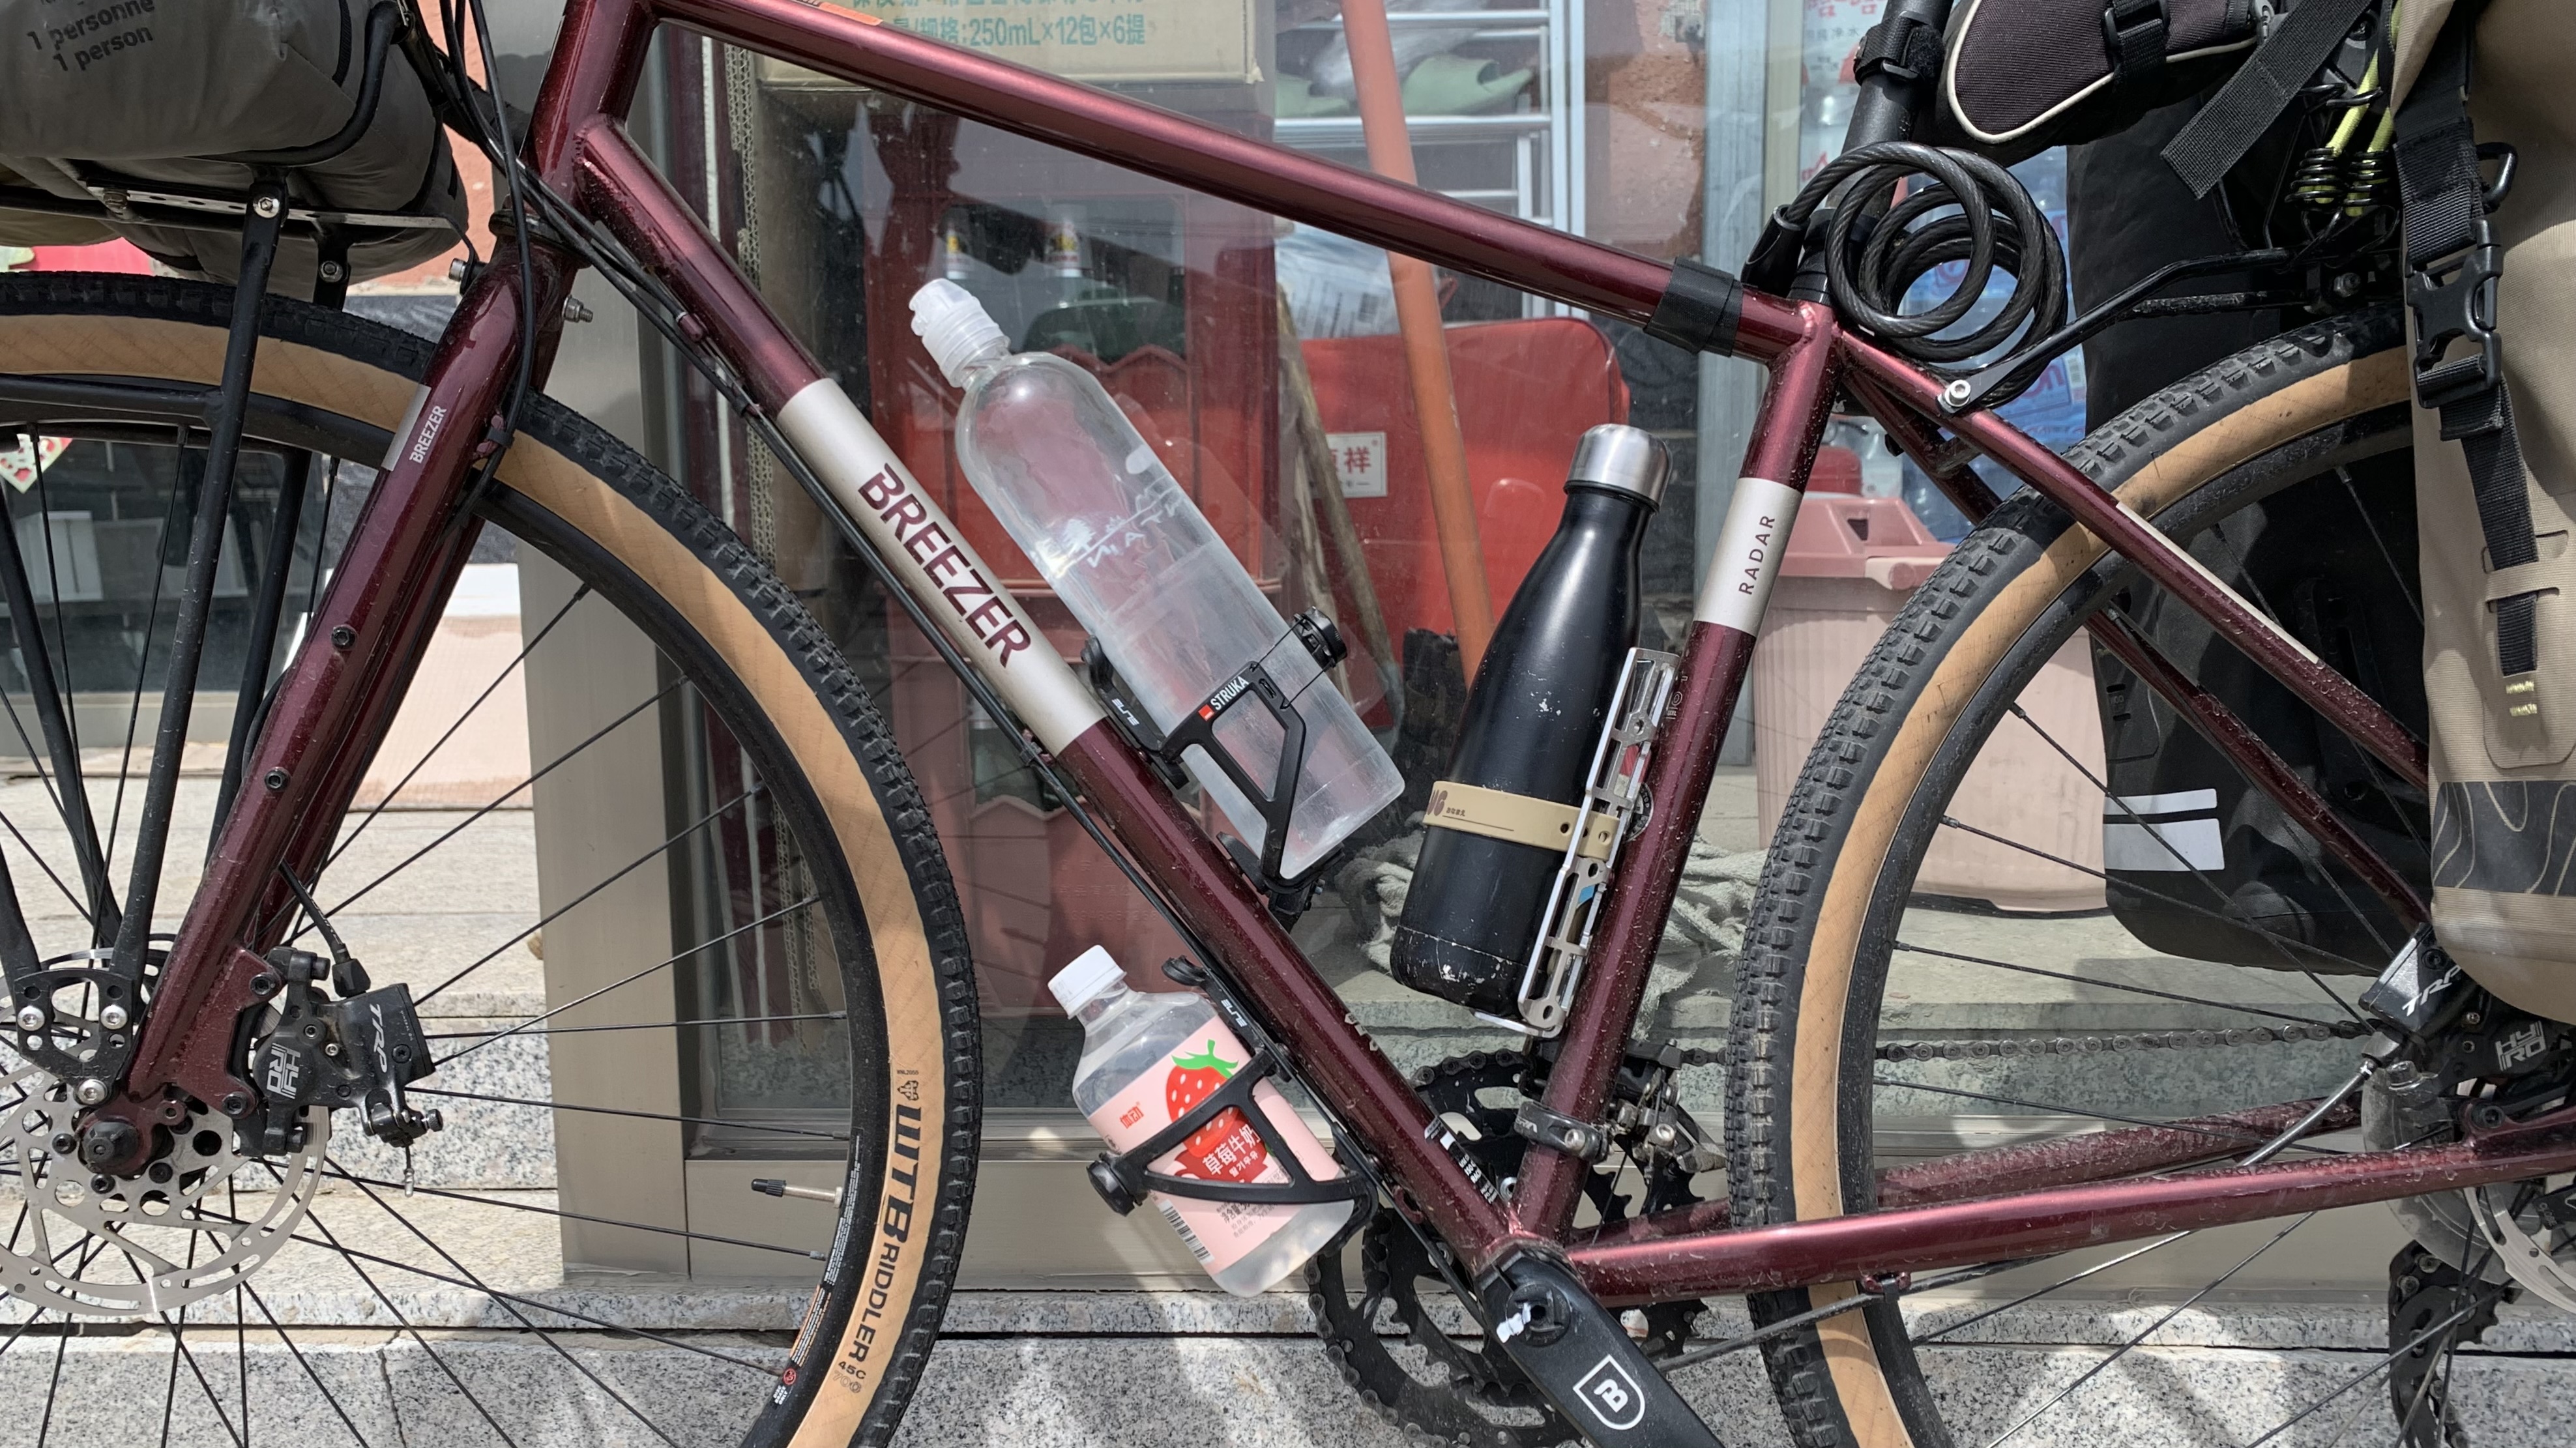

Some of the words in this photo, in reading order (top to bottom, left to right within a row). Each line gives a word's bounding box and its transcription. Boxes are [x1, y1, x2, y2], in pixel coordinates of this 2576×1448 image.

[27, 31, 42, 50] 1
[49, 0, 155, 50] personne
[53, 53, 68, 71] 1
[74, 27, 154, 71] person
[409, 405, 447, 464] BREEZER
[858, 463, 1031, 668] BREEZER
[1738, 515, 1776, 595] RADAR
[1210, 676, 1250, 711] STRUKA
[2401, 964, 2462, 1017] TRP
[369, 1003, 388, 1073] TRP
[883, 1103, 921, 1243] WTB
[1202, 1123, 1261, 1176] 草莓牛奶
[848, 1242, 900, 1363] RIDDLER
[838, 1361, 867, 1380] 45C
[1593, 1378, 1629, 1413] B
